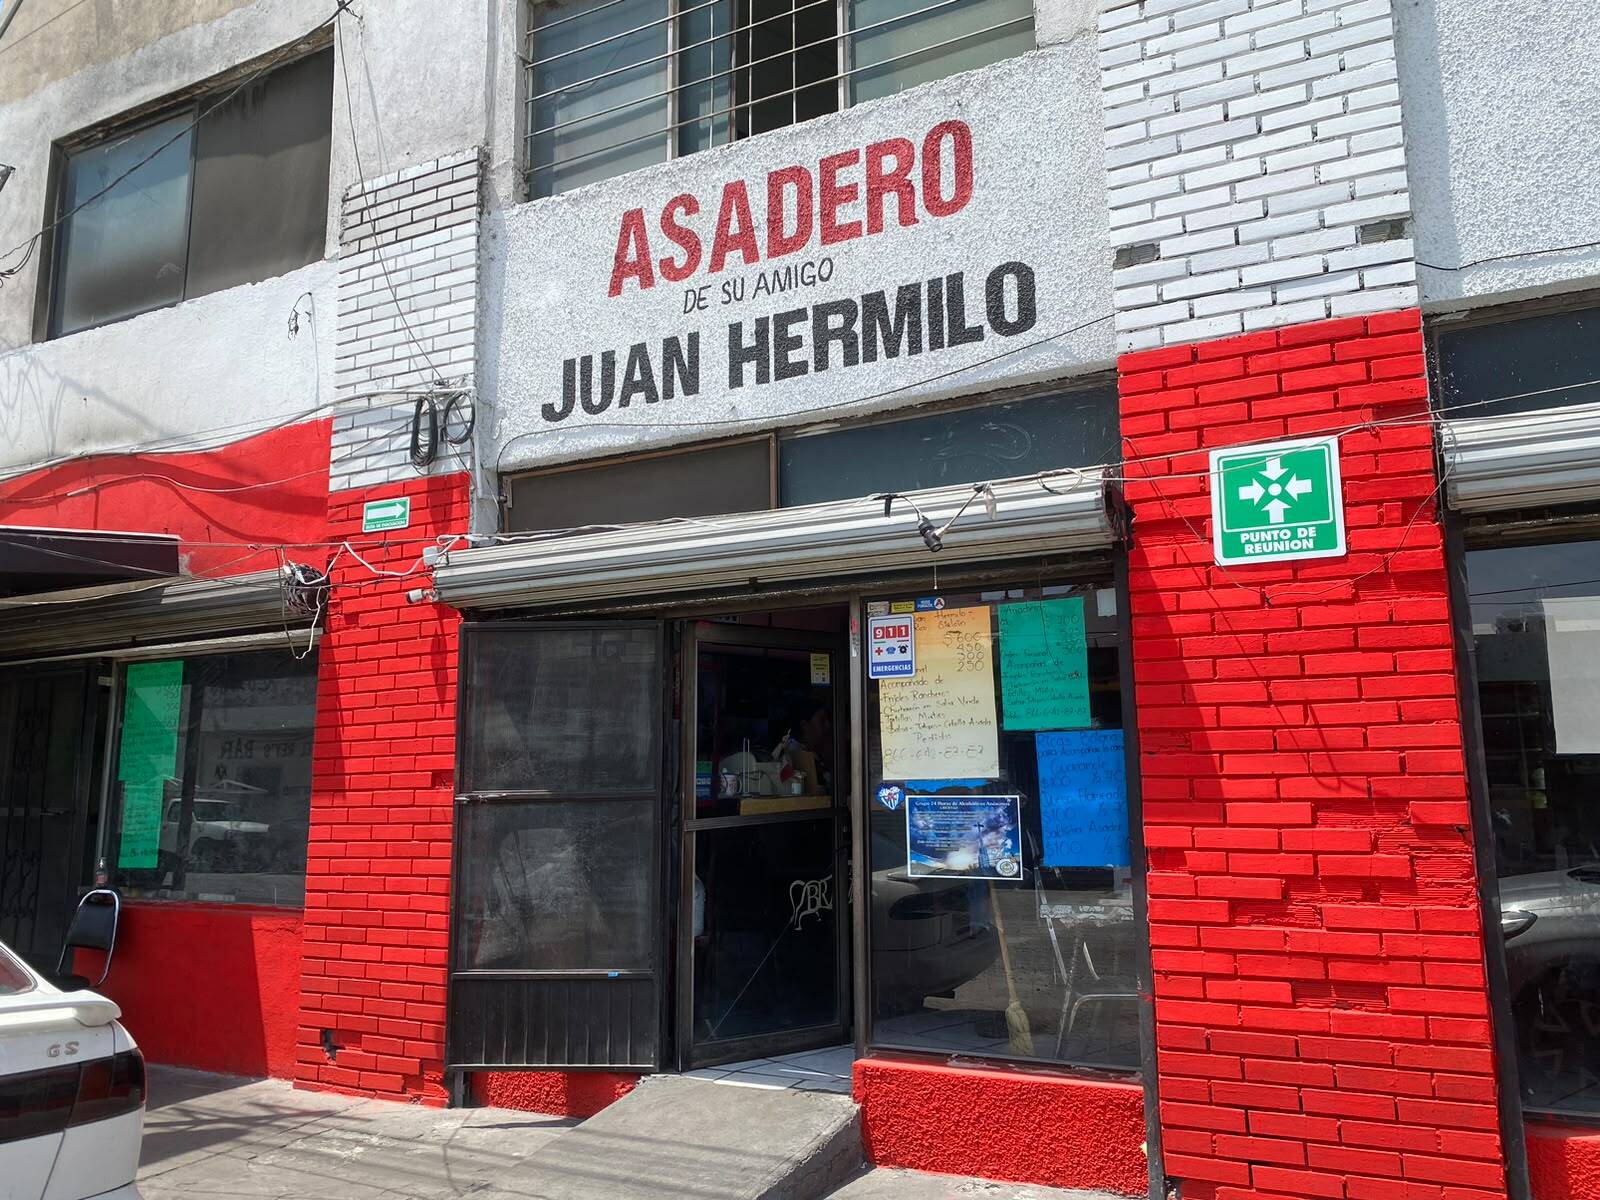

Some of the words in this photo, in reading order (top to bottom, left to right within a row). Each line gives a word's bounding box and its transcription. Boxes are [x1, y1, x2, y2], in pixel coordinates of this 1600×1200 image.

[607, 119, 974, 297] ASADERO
[683, 284, 708, 314] DE
[721, 274, 745, 304] SU
[752, 257, 834, 300] AMIGO
[541, 331, 700, 422] JUAN
[728, 261, 1036, 390] HERMILO
[1240, 528, 1291, 543] PUNTO
[1297, 526, 1317, 538] DE
[1244, 539, 1314, 554] REUNION
[876, 627, 906, 638] 911
[873, 664, 911, 673] EMERGENCIAS
[47, 1041, 80, 1058] GS
